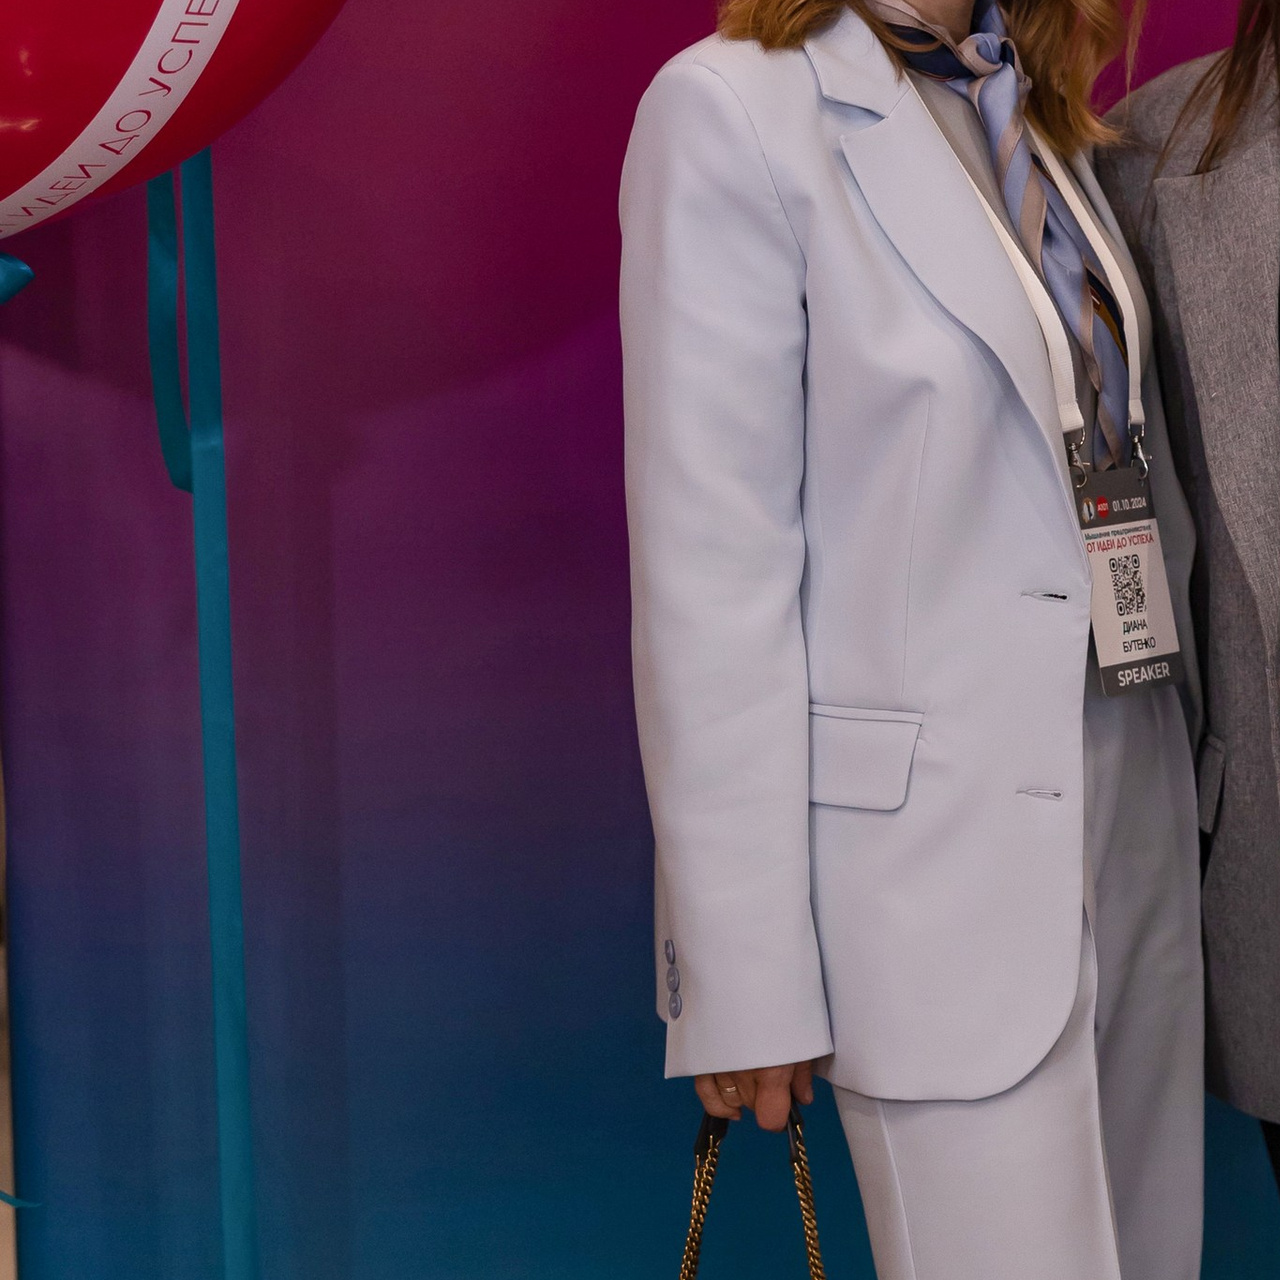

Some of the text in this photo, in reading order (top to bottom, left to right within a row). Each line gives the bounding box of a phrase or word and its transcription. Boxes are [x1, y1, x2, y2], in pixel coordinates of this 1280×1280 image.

[6, 164, 107, 217] ИДЕИ
[98, 109, 152, 155] ДО
[1112, 496, 1147, 512] 01.10.2024
[1086, 532, 1155, 553] ОТ ИДЕИ ДО УСПЕХА
[1122, 618, 1148, 636] ДИАНА
[1122, 636, 1157, 653] БУТЕНКО
[1117, 661, 1171, 687] SPEAKER
